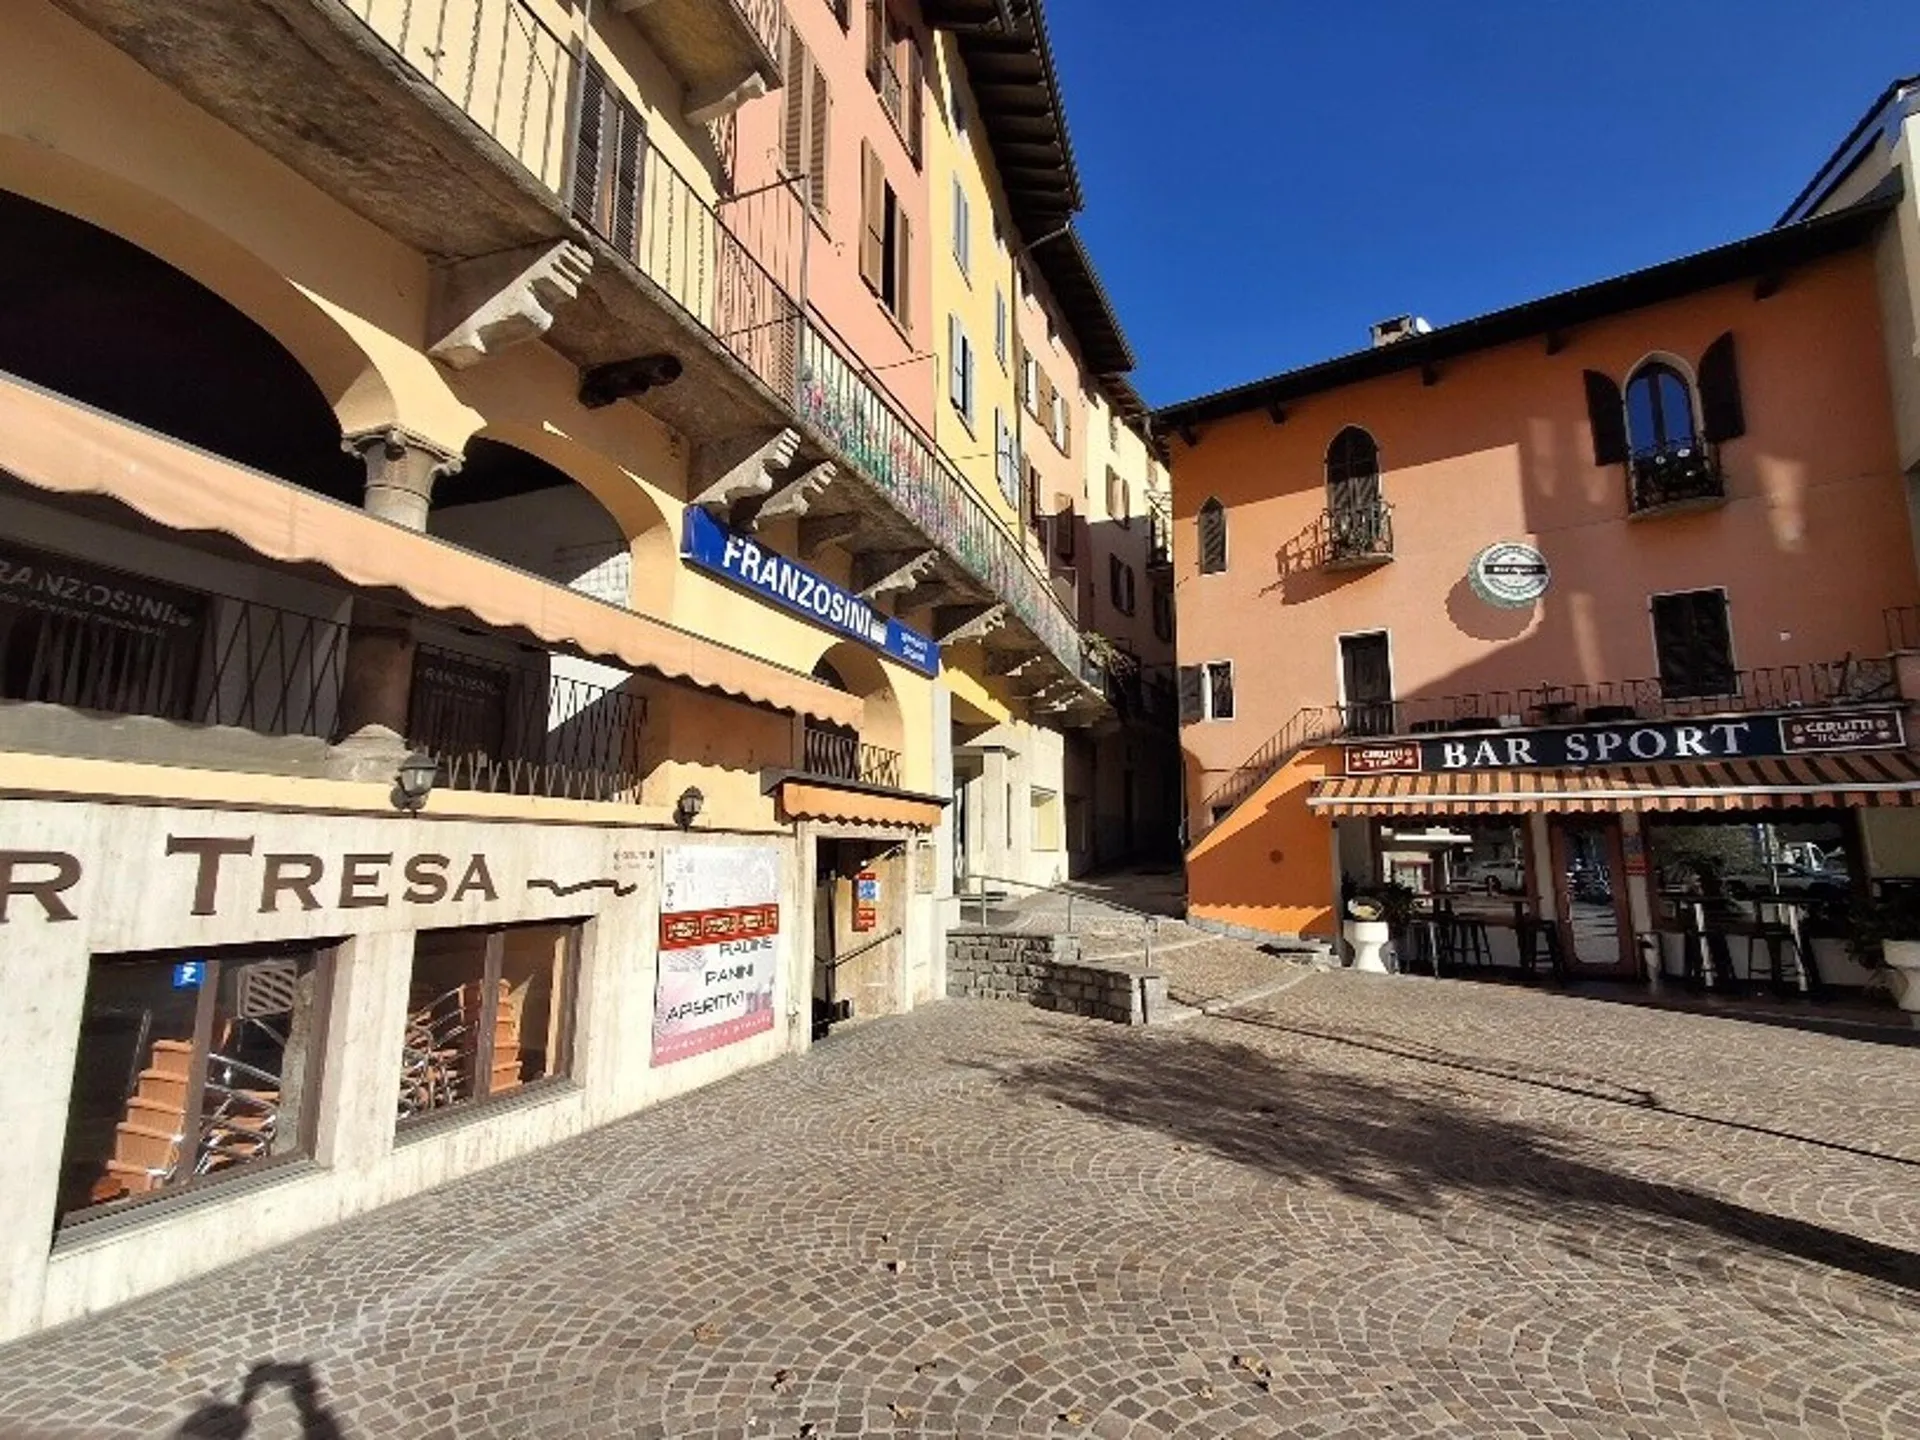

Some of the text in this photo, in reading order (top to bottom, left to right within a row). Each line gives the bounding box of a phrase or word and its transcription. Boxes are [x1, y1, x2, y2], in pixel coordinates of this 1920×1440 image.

[722, 534, 872, 637] FRANZOSINI
[1442, 722, 1750, 768] BAR SPORT
[1805, 719, 1875, 733] CERUTTI
